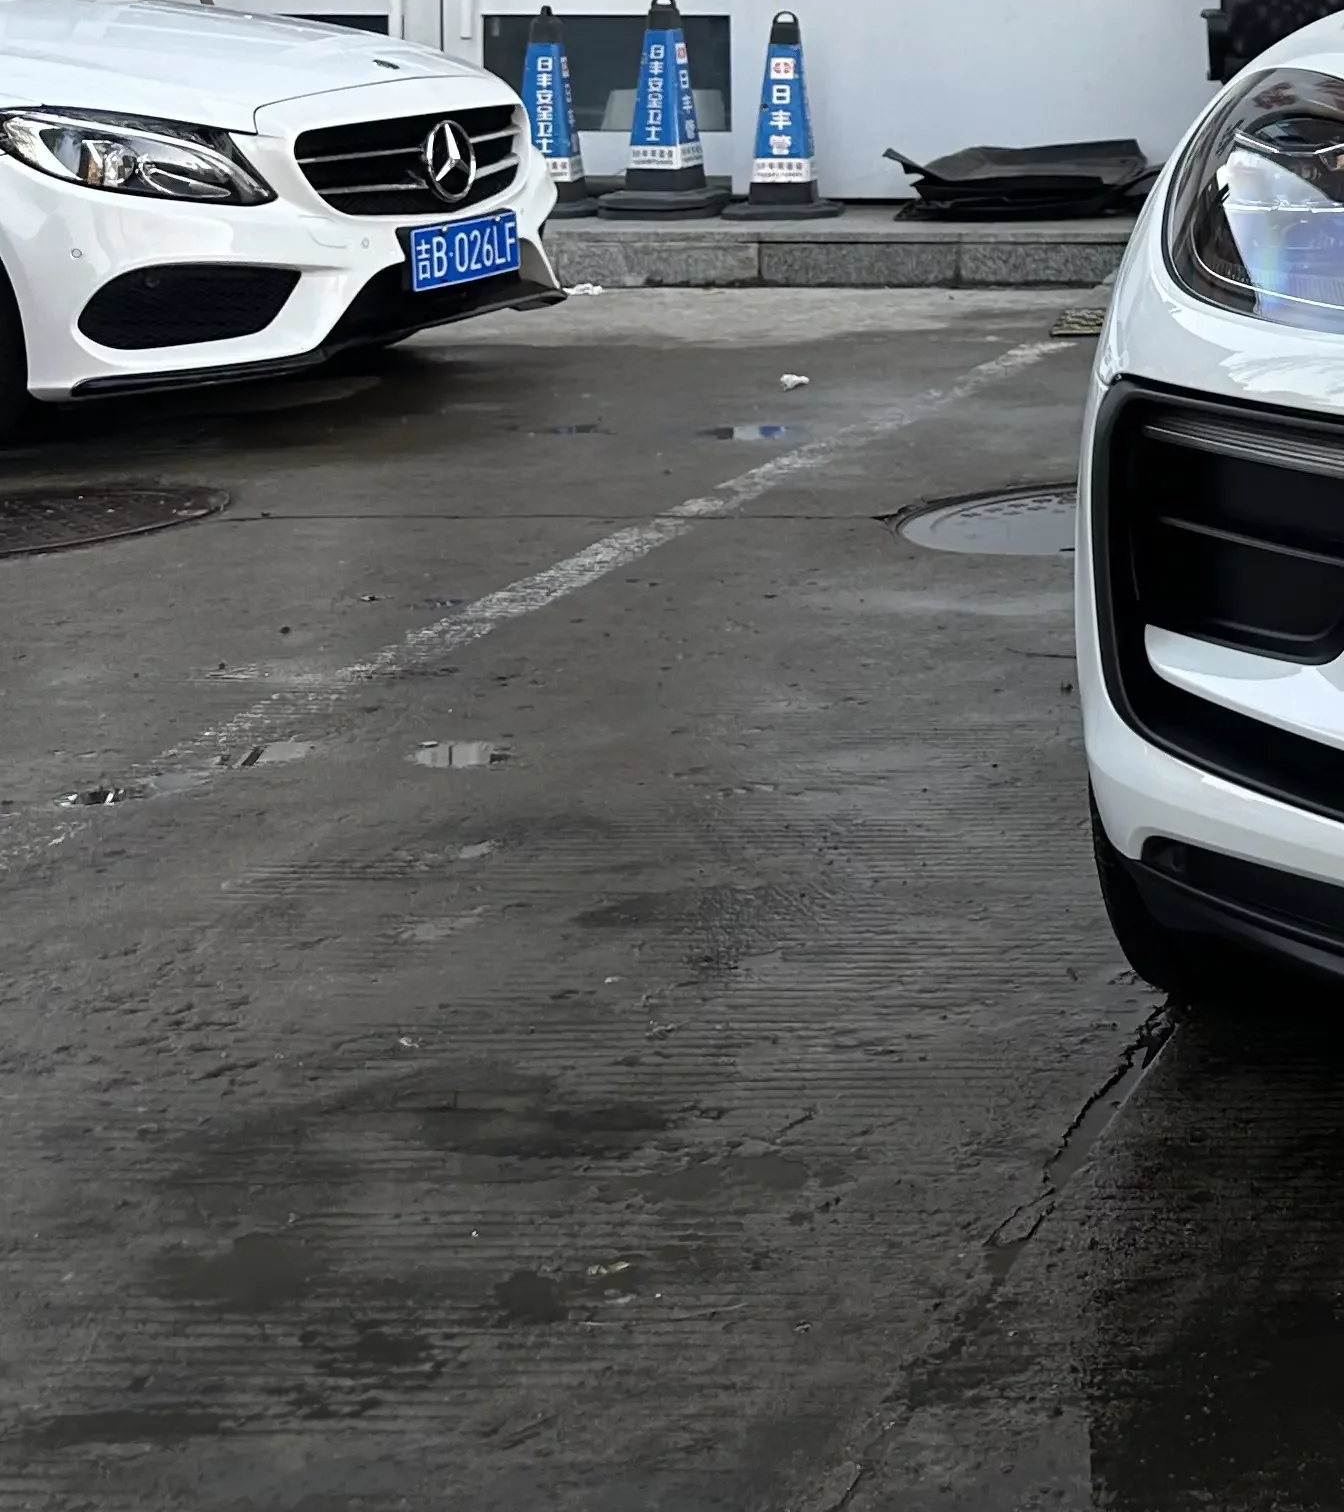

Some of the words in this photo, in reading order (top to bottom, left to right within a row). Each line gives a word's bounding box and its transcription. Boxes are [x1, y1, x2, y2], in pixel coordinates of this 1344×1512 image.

[535, 56, 554, 153] 日丰安全卫士
[646, 44, 665, 142] 日丰安全卫士
